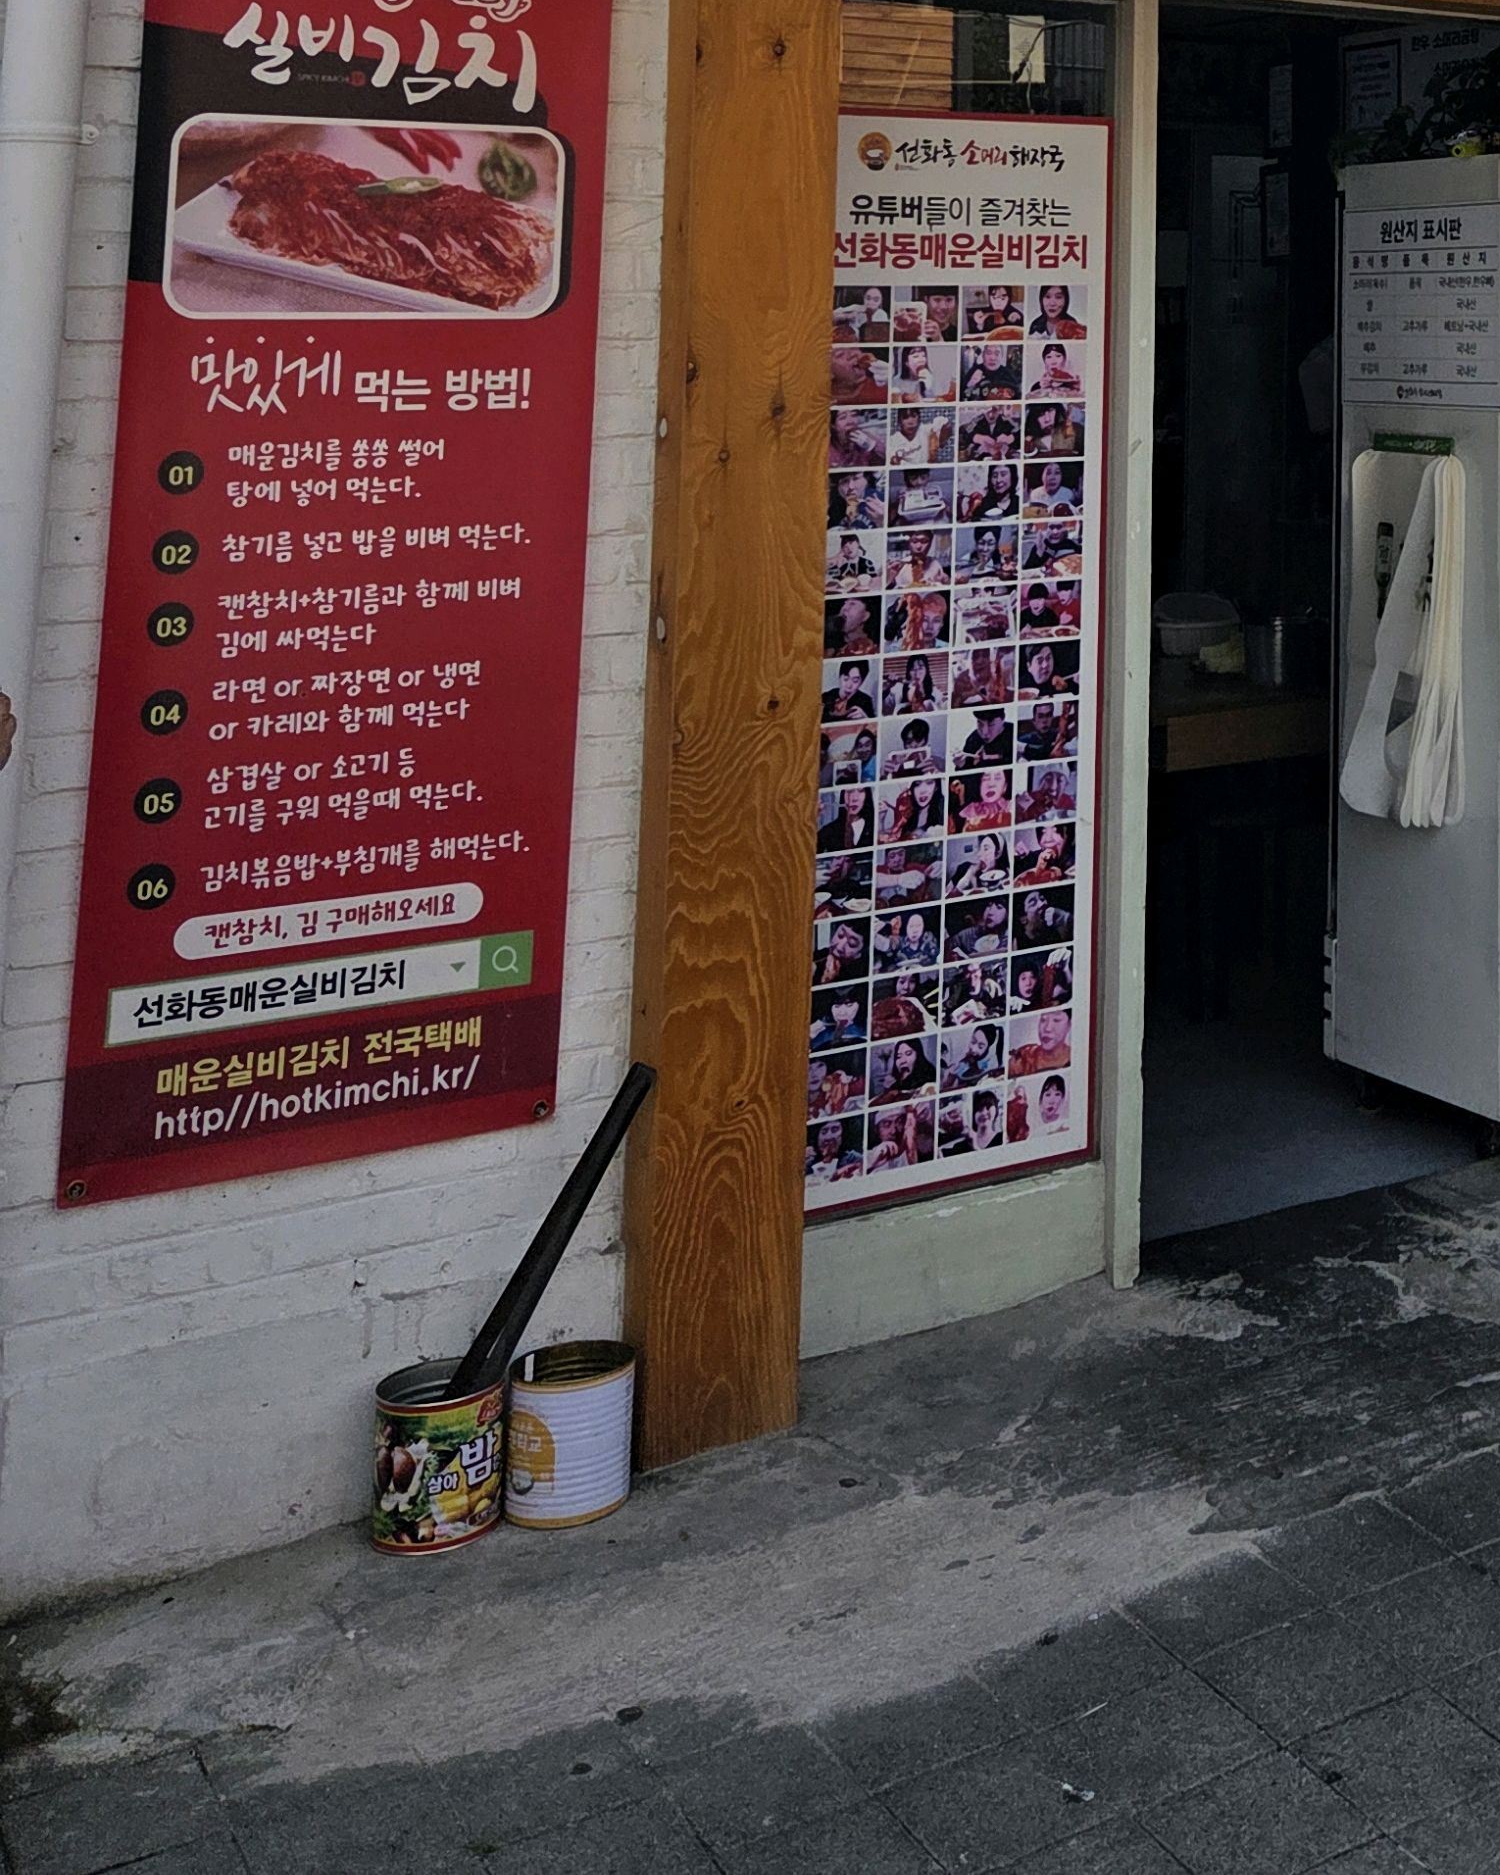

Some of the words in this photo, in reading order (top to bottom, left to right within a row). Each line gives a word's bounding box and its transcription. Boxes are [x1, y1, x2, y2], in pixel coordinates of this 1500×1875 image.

[222, 1, 538, 113] 실비김치
[894, 138, 960, 168] 선화동
[849, 193, 972, 227] 유튜버들이
[978, 196, 1072, 228] 즐겨찾는
[1379, 218, 1419, 244] 원산지
[1421, 216, 1463, 242] 표시판
[190, 338, 342, 416] 맛있게
[353, 368, 432, 413] 먹는
[444, 367, 532, 412] 방법!
[168, 465, 195, 486] 01
[227, 437, 343, 472] 매운김치를
[397, 438, 446, 467] 썰어
[225, 479, 282, 509] 탕에
[290, 477, 338, 507] 넣어
[345, 475, 423, 502] 먹는다.
[160, 542, 193, 566] 02
[221, 529, 294, 563] 참기름
[303, 530, 345, 560] 넣고
[351, 525, 397, 558] 밥을
[404, 524, 451, 550] 비벼
[457, 521, 532, 553] 먹는다.
[155, 615, 188, 639] 03
[414, 578, 470, 610] 함께
[476, 576, 522, 601] 비벼
[215, 630, 268, 659] 김에
[149, 704, 182, 728] 04
[211, 676, 267, 704] 라면
[273, 678, 303, 699] or
[310, 667, 392, 698] 짜장면
[397, 668, 427, 689] or
[432, 660, 482, 689] 냉면
[207, 720, 240, 741] or
[247, 709, 330, 740] 카레와
[337, 703, 395, 734] 함께
[401, 698, 471, 729] 먹는다
[142, 792, 176, 816] 05
[206, 761, 287, 796] 삼겹살
[293, 762, 324, 783] or
[329, 749, 391, 781] 소고기
[398, 746, 417, 779] 등
[203, 800, 267, 834] 고기를
[275, 794, 320, 825] 구워
[327, 785, 402, 821] 먹을때
[408, 779, 484, 810] 먹는다.
[135, 878, 169, 902] 06
[199, 839, 422, 894] 김치볶음밥+부침개를
[428, 829, 532, 862] 해먹는다.
[203, 921, 289, 951] 캔참치,
[132, 958, 408, 1030] 선화동매운실비김치
[155, 1034, 351, 1098] 매운실비김치
[362, 1015, 483, 1067] 전국택배
[153, 1054, 481, 1142] http//hotkimchi.kr/
